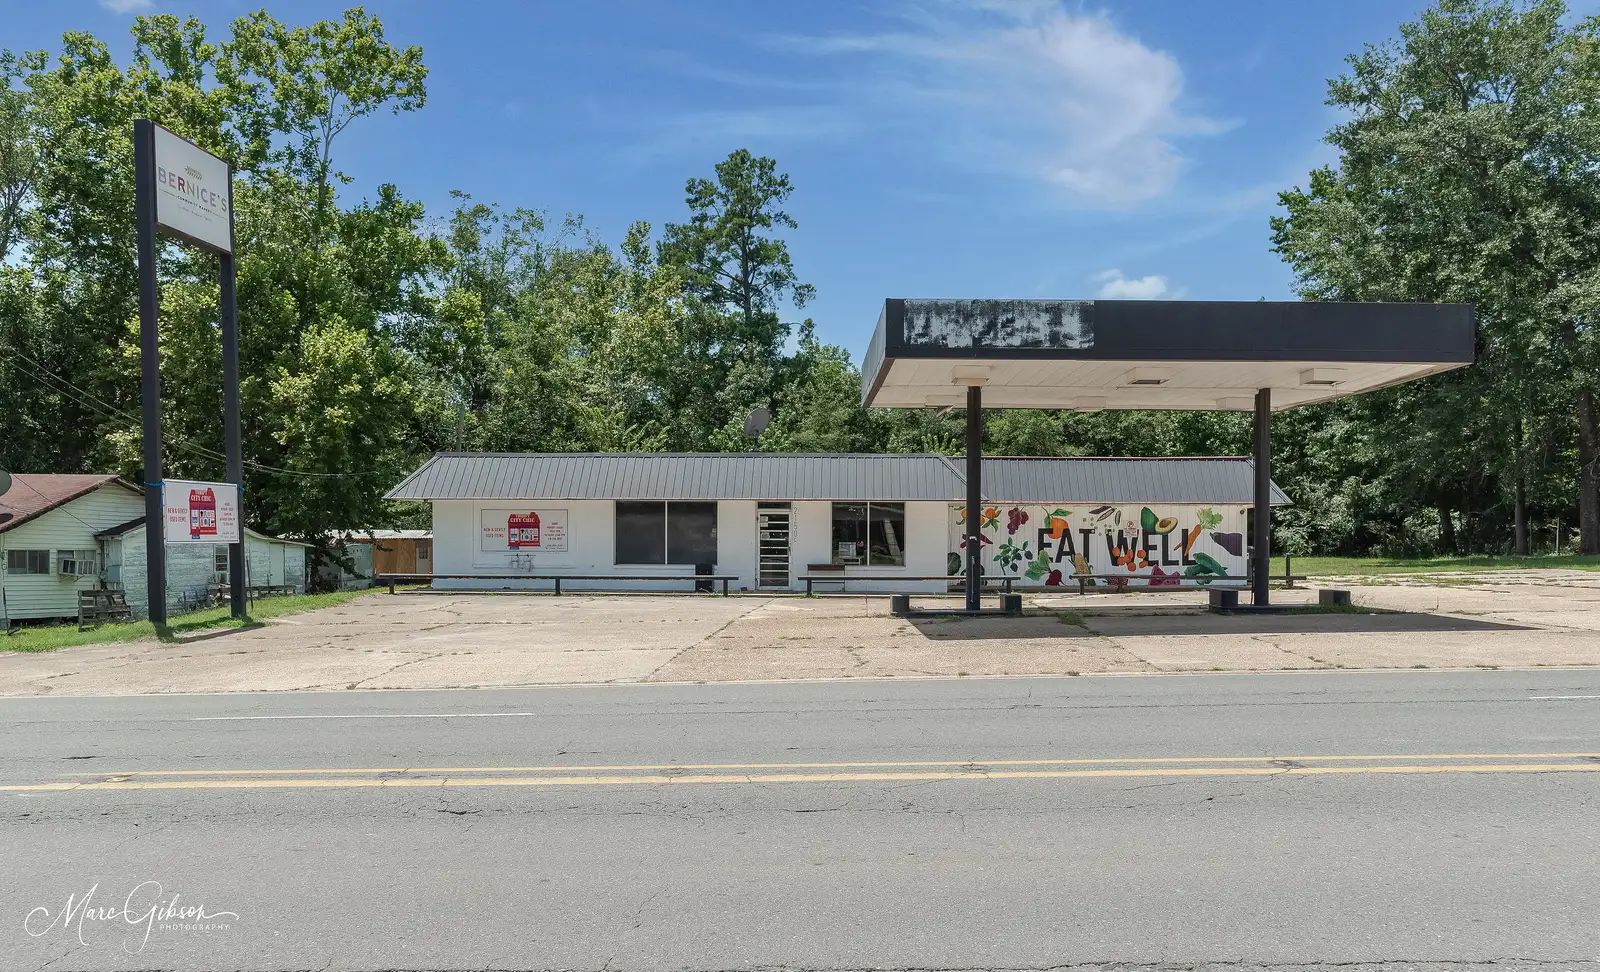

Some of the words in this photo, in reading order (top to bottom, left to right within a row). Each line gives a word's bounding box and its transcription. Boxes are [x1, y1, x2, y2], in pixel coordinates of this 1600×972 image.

[158, 166, 228, 213] BERNICE'S
[1037, 528, 1096, 564] EAT
[1105, 528, 1198, 567] WELL
